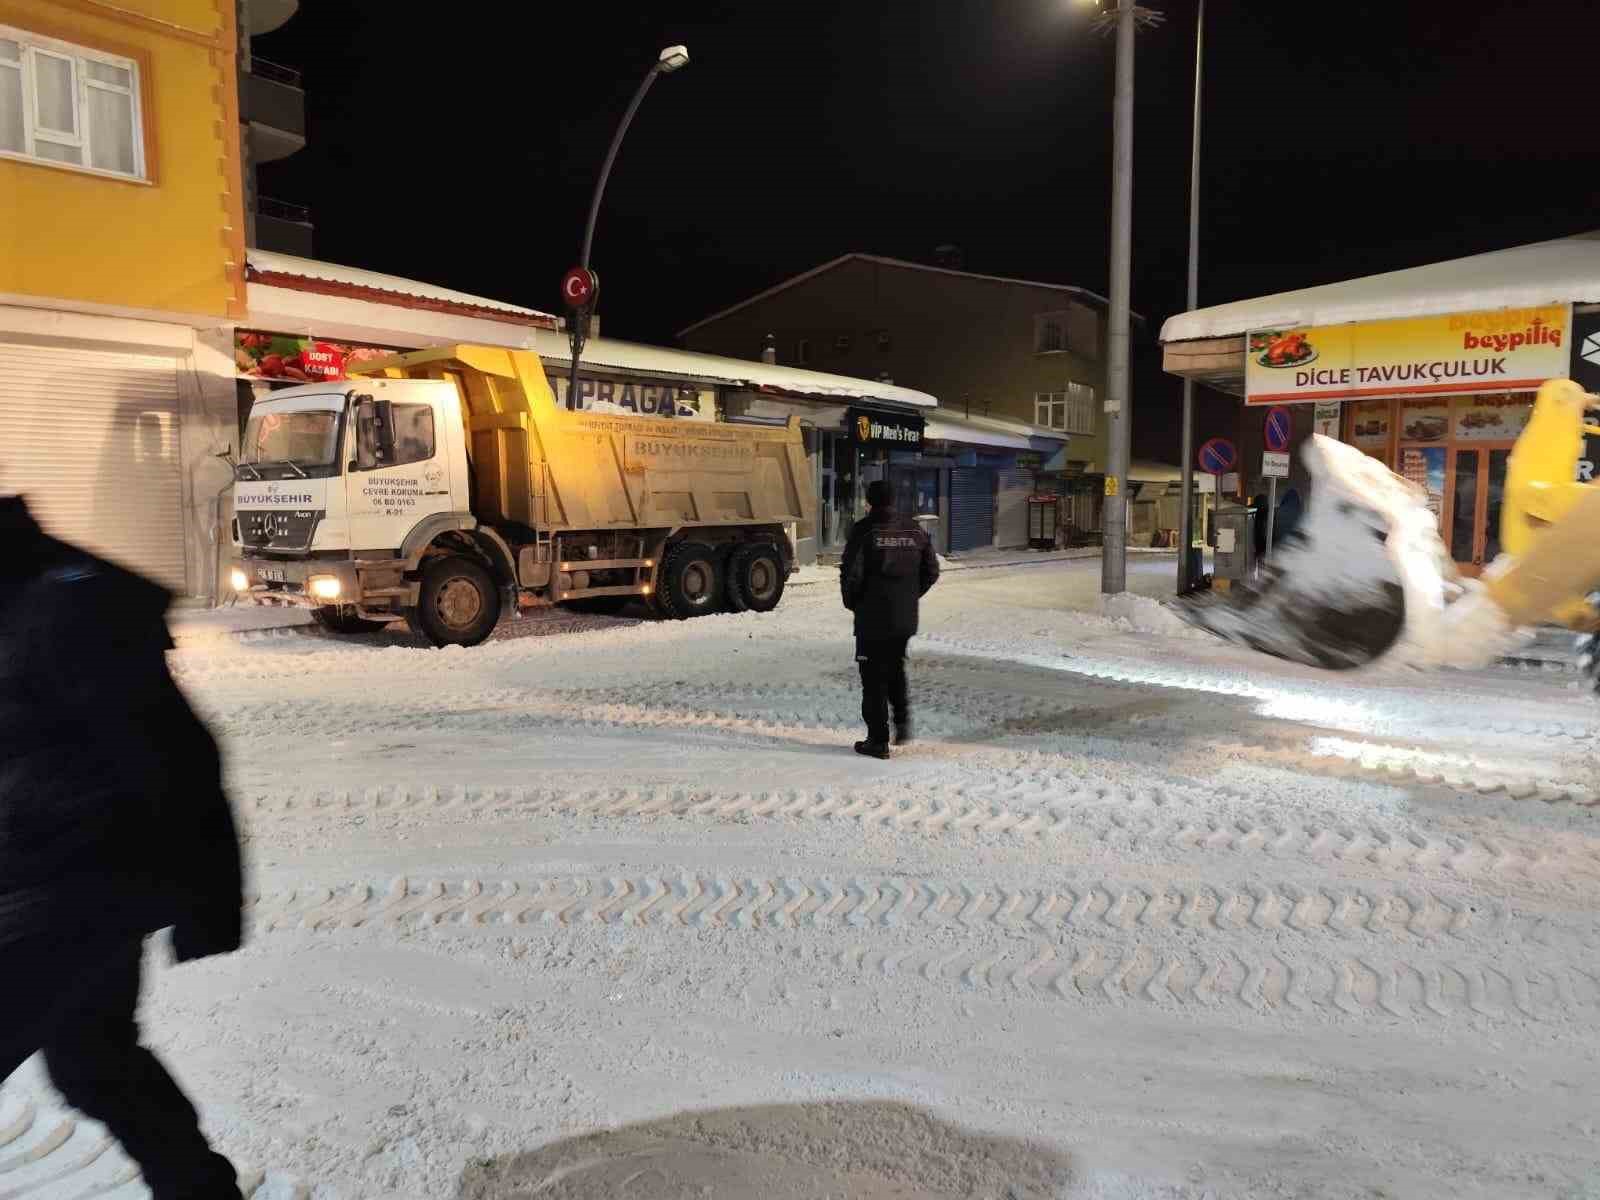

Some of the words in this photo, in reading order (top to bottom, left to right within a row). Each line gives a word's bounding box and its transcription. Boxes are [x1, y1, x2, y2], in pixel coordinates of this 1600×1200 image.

[1464, 322, 1562, 352] beypiliç
[1296, 368, 1350, 387] DİCLE
[1356, 358, 1507, 382] TAVUKÇULUK
[566, 377, 694, 416] PRAGA
